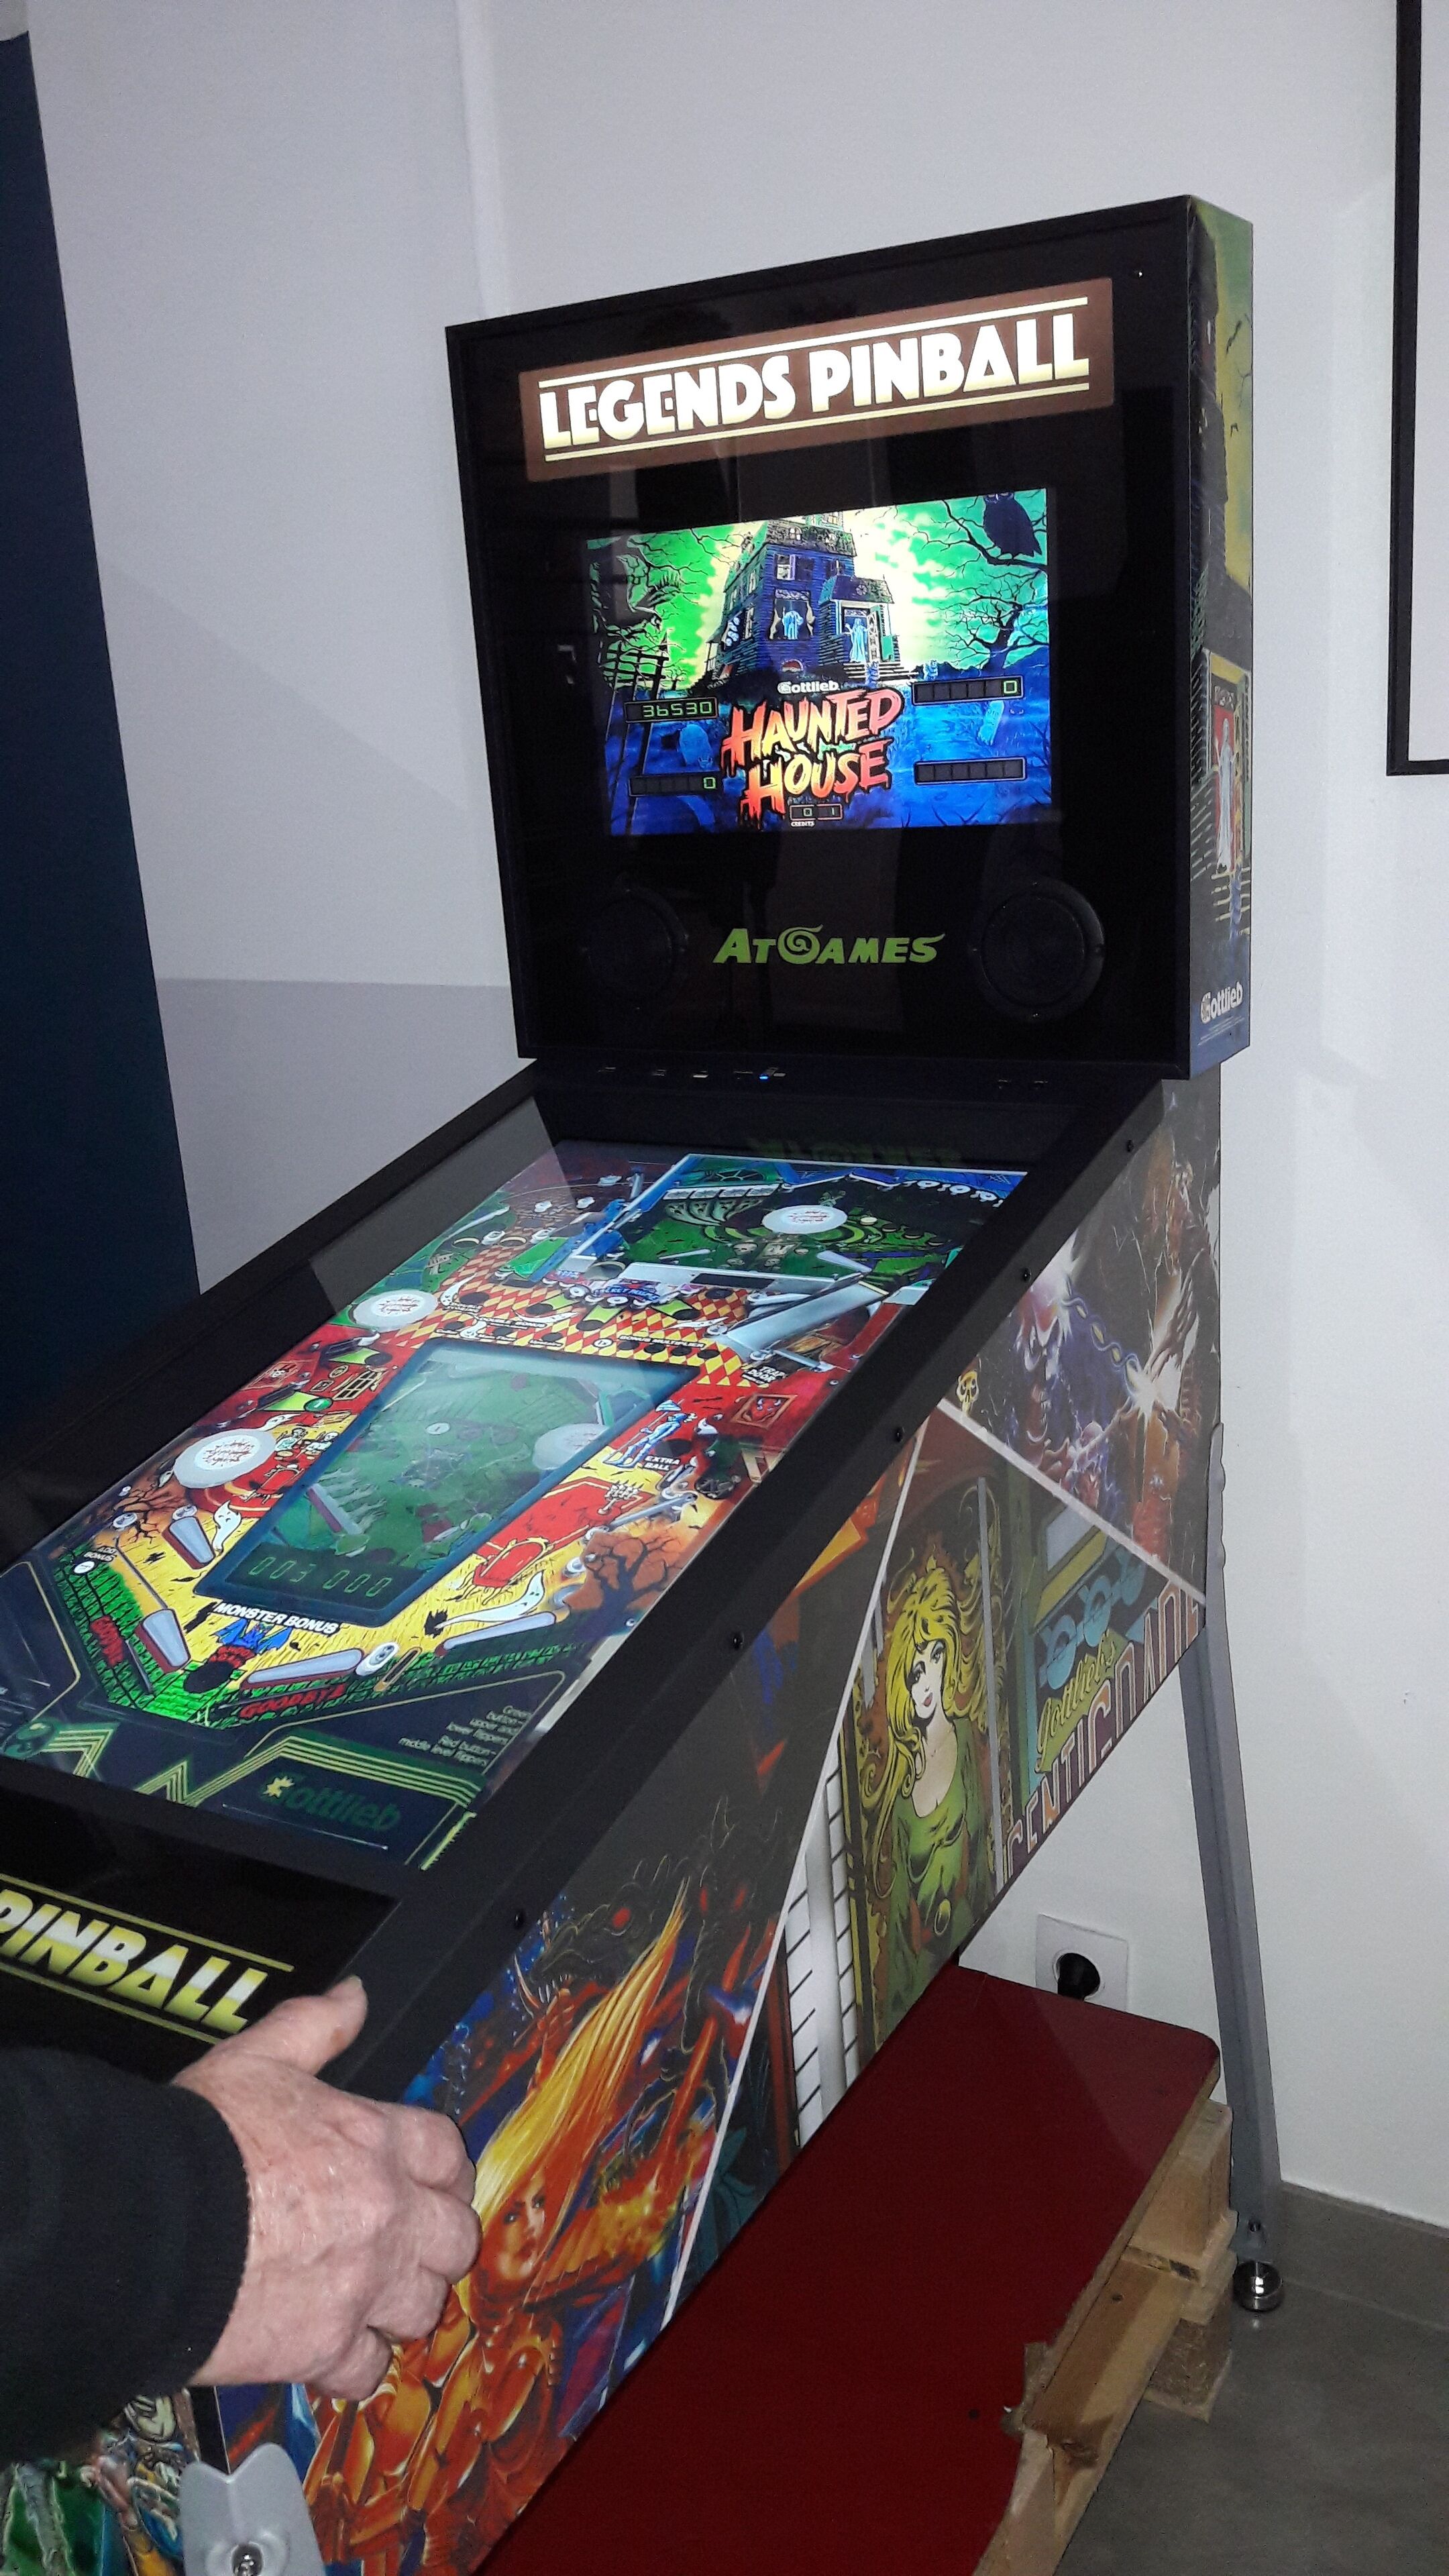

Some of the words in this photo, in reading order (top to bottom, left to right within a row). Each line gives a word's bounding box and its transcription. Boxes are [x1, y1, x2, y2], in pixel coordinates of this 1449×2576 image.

[539, 354, 796, 449] LEGENDS
[808, 313, 1089, 413] PINBALL
[777, 680, 839, 694] Gottlieb
[721, 688, 902, 774] HAUNTED
[741, 739, 893, 829] HOUSE
[1200, 981, 1243, 1024] Gottlieb
[653, 1338, 704, 1348] MULTIPLIER
[747, 1369, 776, 1383] DOOR
[644, 1462, 669, 1470] BALL
[645, 1456, 680, 1465] EXTRA
[214, 1603, 287, 1625] MONSTER
[284, 1616, 339, 1634] BONUS
[0, 1888, 268, 2033] PINBALL
